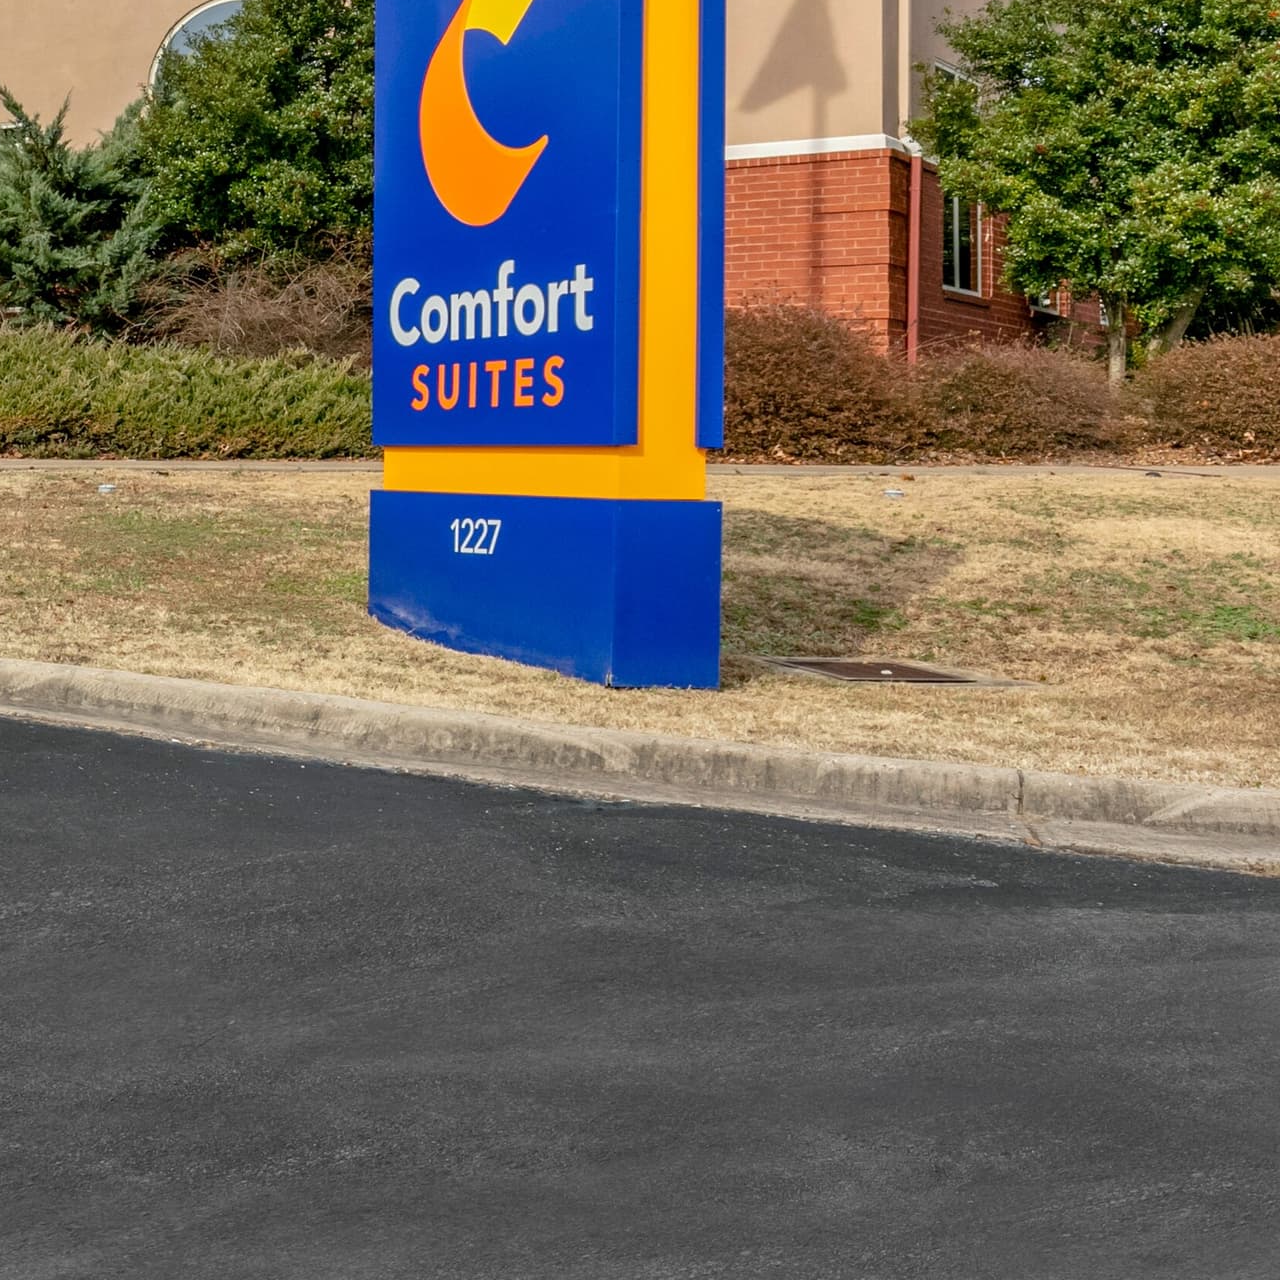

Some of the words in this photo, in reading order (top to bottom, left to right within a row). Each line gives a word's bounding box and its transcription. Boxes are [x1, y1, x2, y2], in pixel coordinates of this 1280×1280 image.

[390, 259, 594, 347] Comfort
[410, 355, 565, 411] SUITES
[450, 518, 502, 555] 1227
